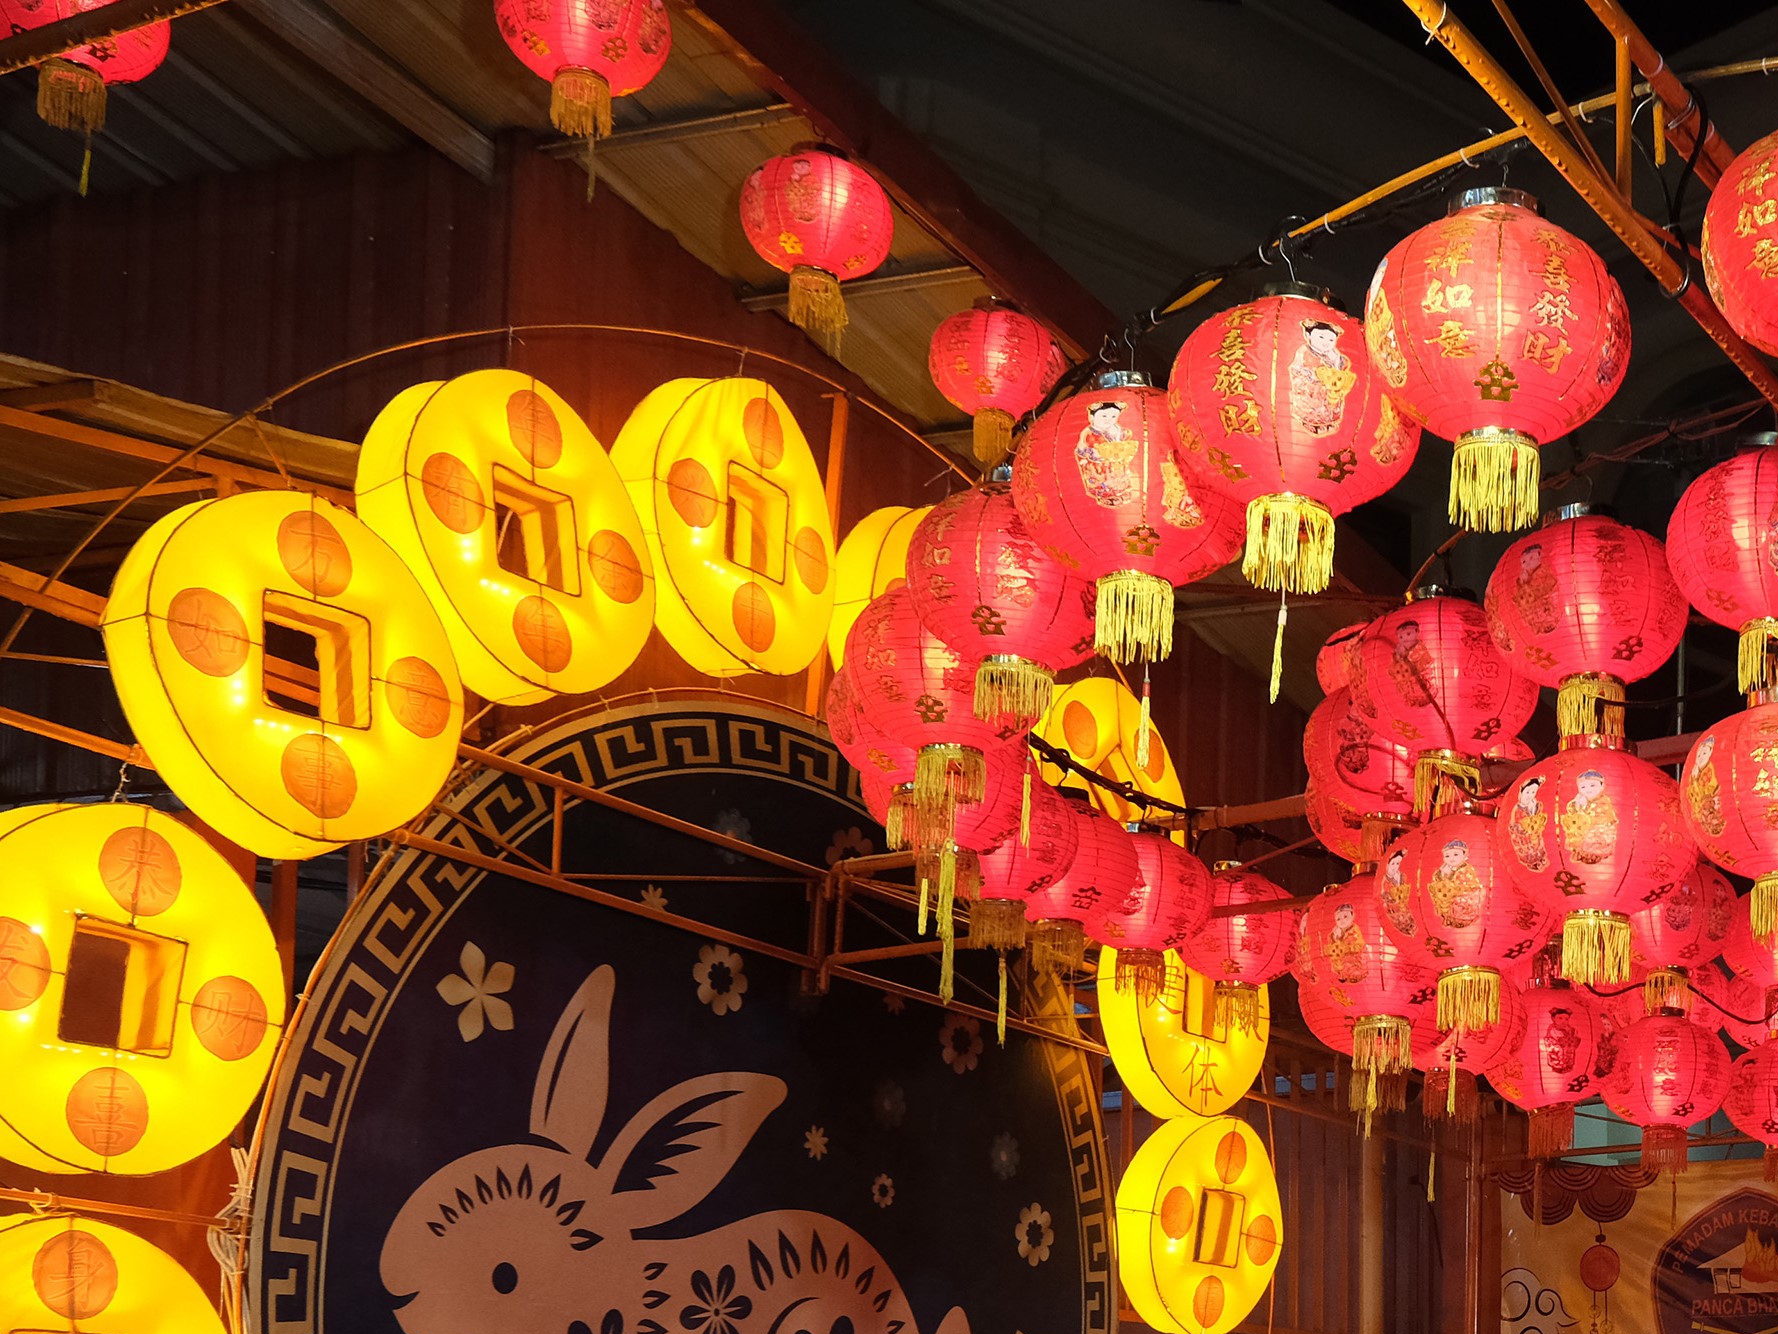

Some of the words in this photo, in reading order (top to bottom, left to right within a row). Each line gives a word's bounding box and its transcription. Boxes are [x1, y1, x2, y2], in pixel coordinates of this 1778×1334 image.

[1519, 227, 1579, 374] 恭喜發財
[1208, 305, 1264, 438] 恭喜發財
[169, 597, 240, 660] 如
[198, 989, 263, 1053] 财
[1182, 1043, 1224, 1107] 体
[74, 1072, 137, 1147] 喜
[1672, 1212, 1734, 1274] PEMADAM
[1691, 1299, 1744, 1316] PANCA
